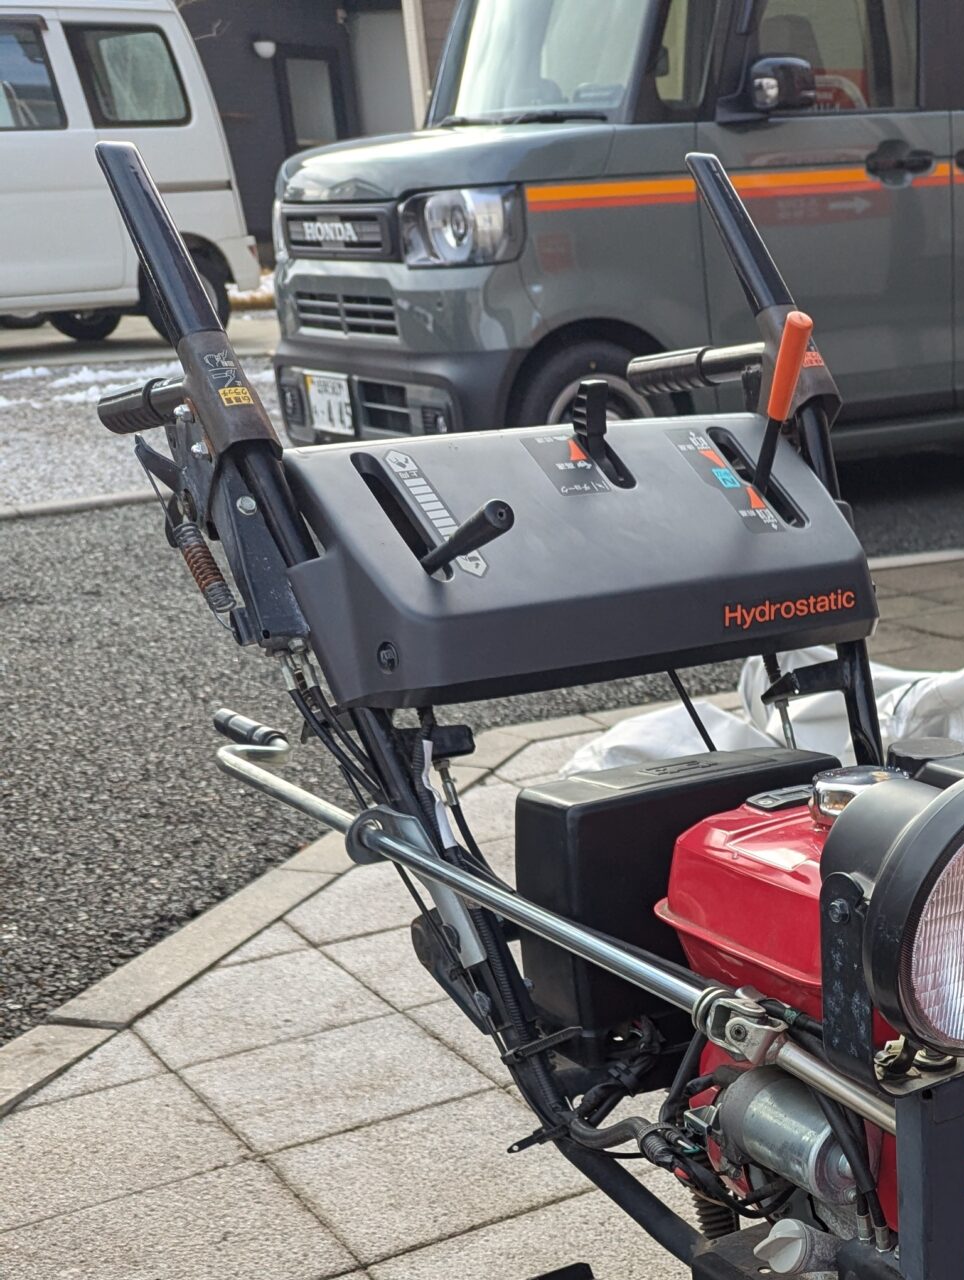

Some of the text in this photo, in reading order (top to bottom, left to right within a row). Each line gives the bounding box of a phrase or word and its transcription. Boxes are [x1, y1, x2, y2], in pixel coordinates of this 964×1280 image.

[303, 222, 358, 241] HONDA
[561, 483, 591, 493] チョーク
[724, 589, 856, 629] Hydrostatic
